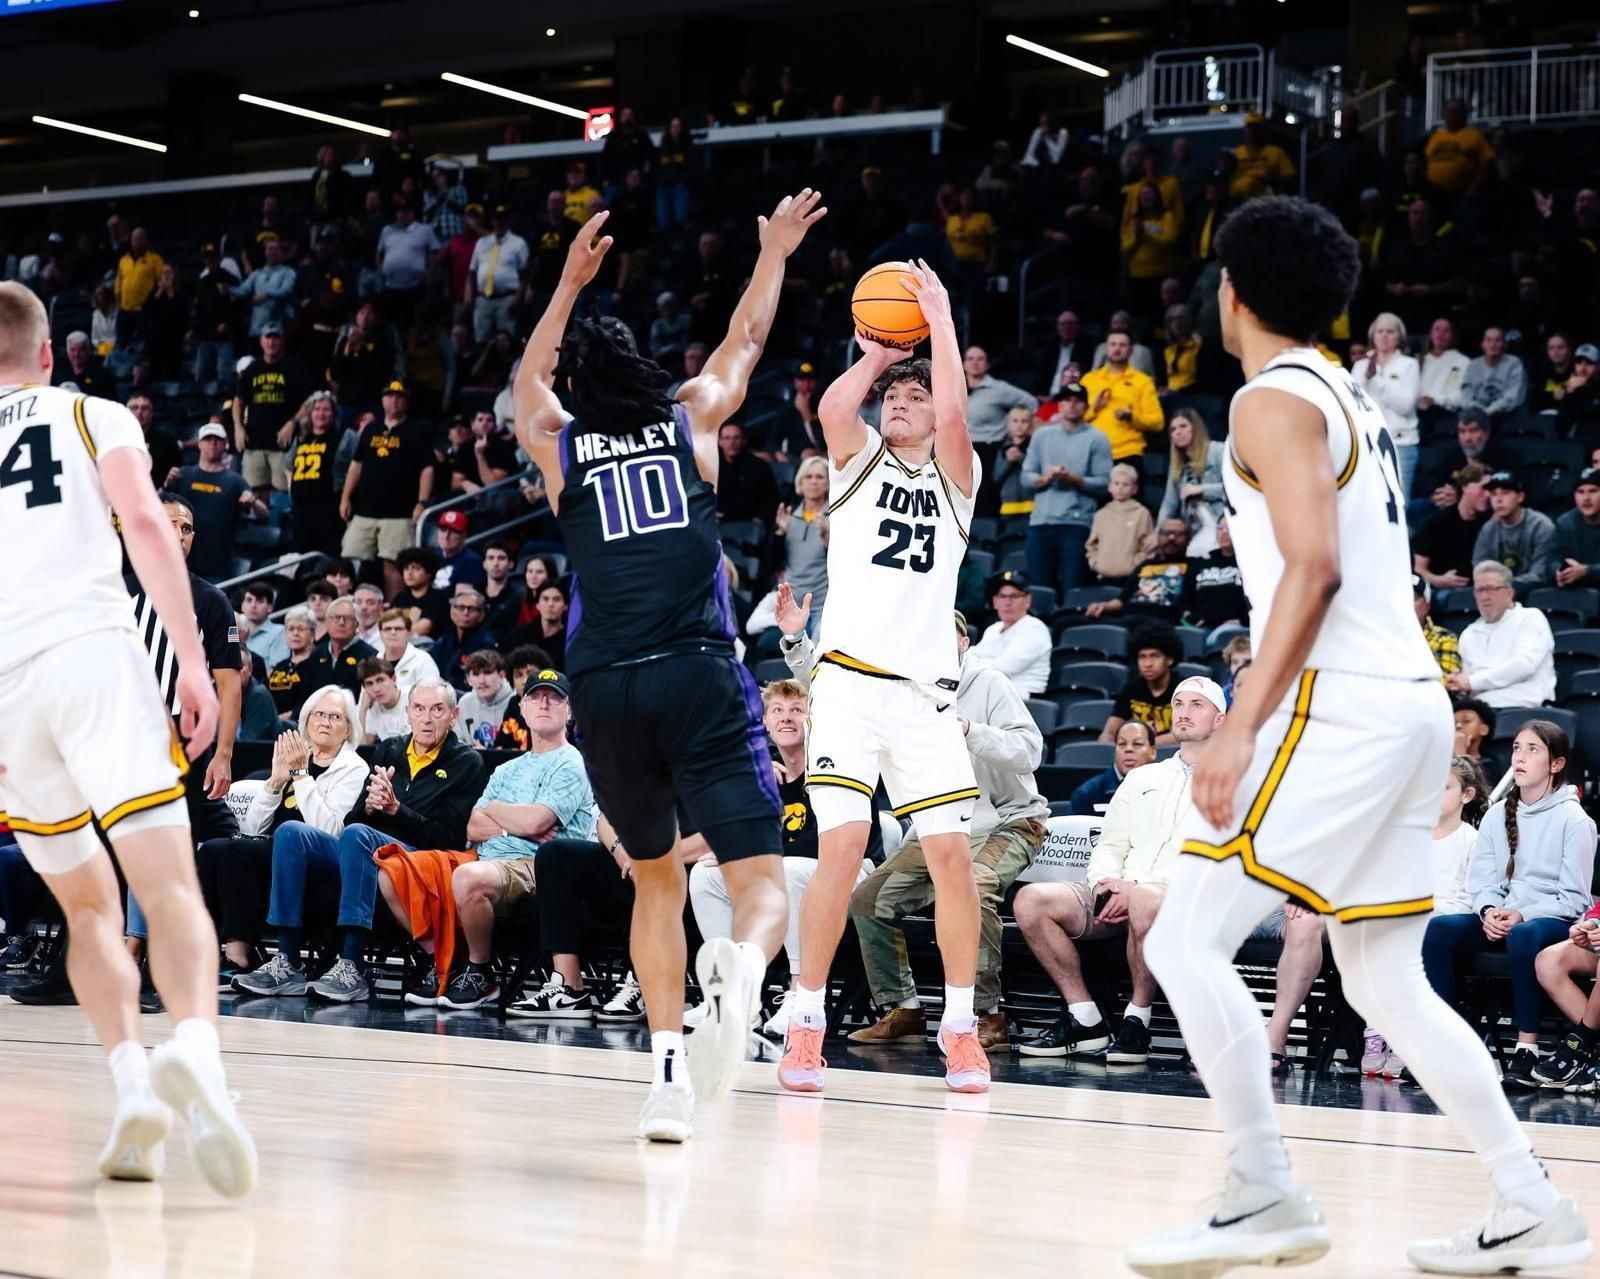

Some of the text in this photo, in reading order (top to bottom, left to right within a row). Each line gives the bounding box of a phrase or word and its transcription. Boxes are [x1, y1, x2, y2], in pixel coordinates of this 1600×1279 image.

[252, 373, 285, 387] IOWA
[574, 422, 677, 464] HENLEY
[0, 424, 63, 509] 4
[293, 454, 321, 481] 22
[582, 454, 689, 541] 10
[876, 481, 941, 518] IOWA
[871, 518, 936, 573] 23
[225, 793, 255, 804] Moder
[229, 804, 249, 815] ood
[1035, 859, 1065, 867] RATERNAL
[1037, 845, 1092, 860] Woodme
